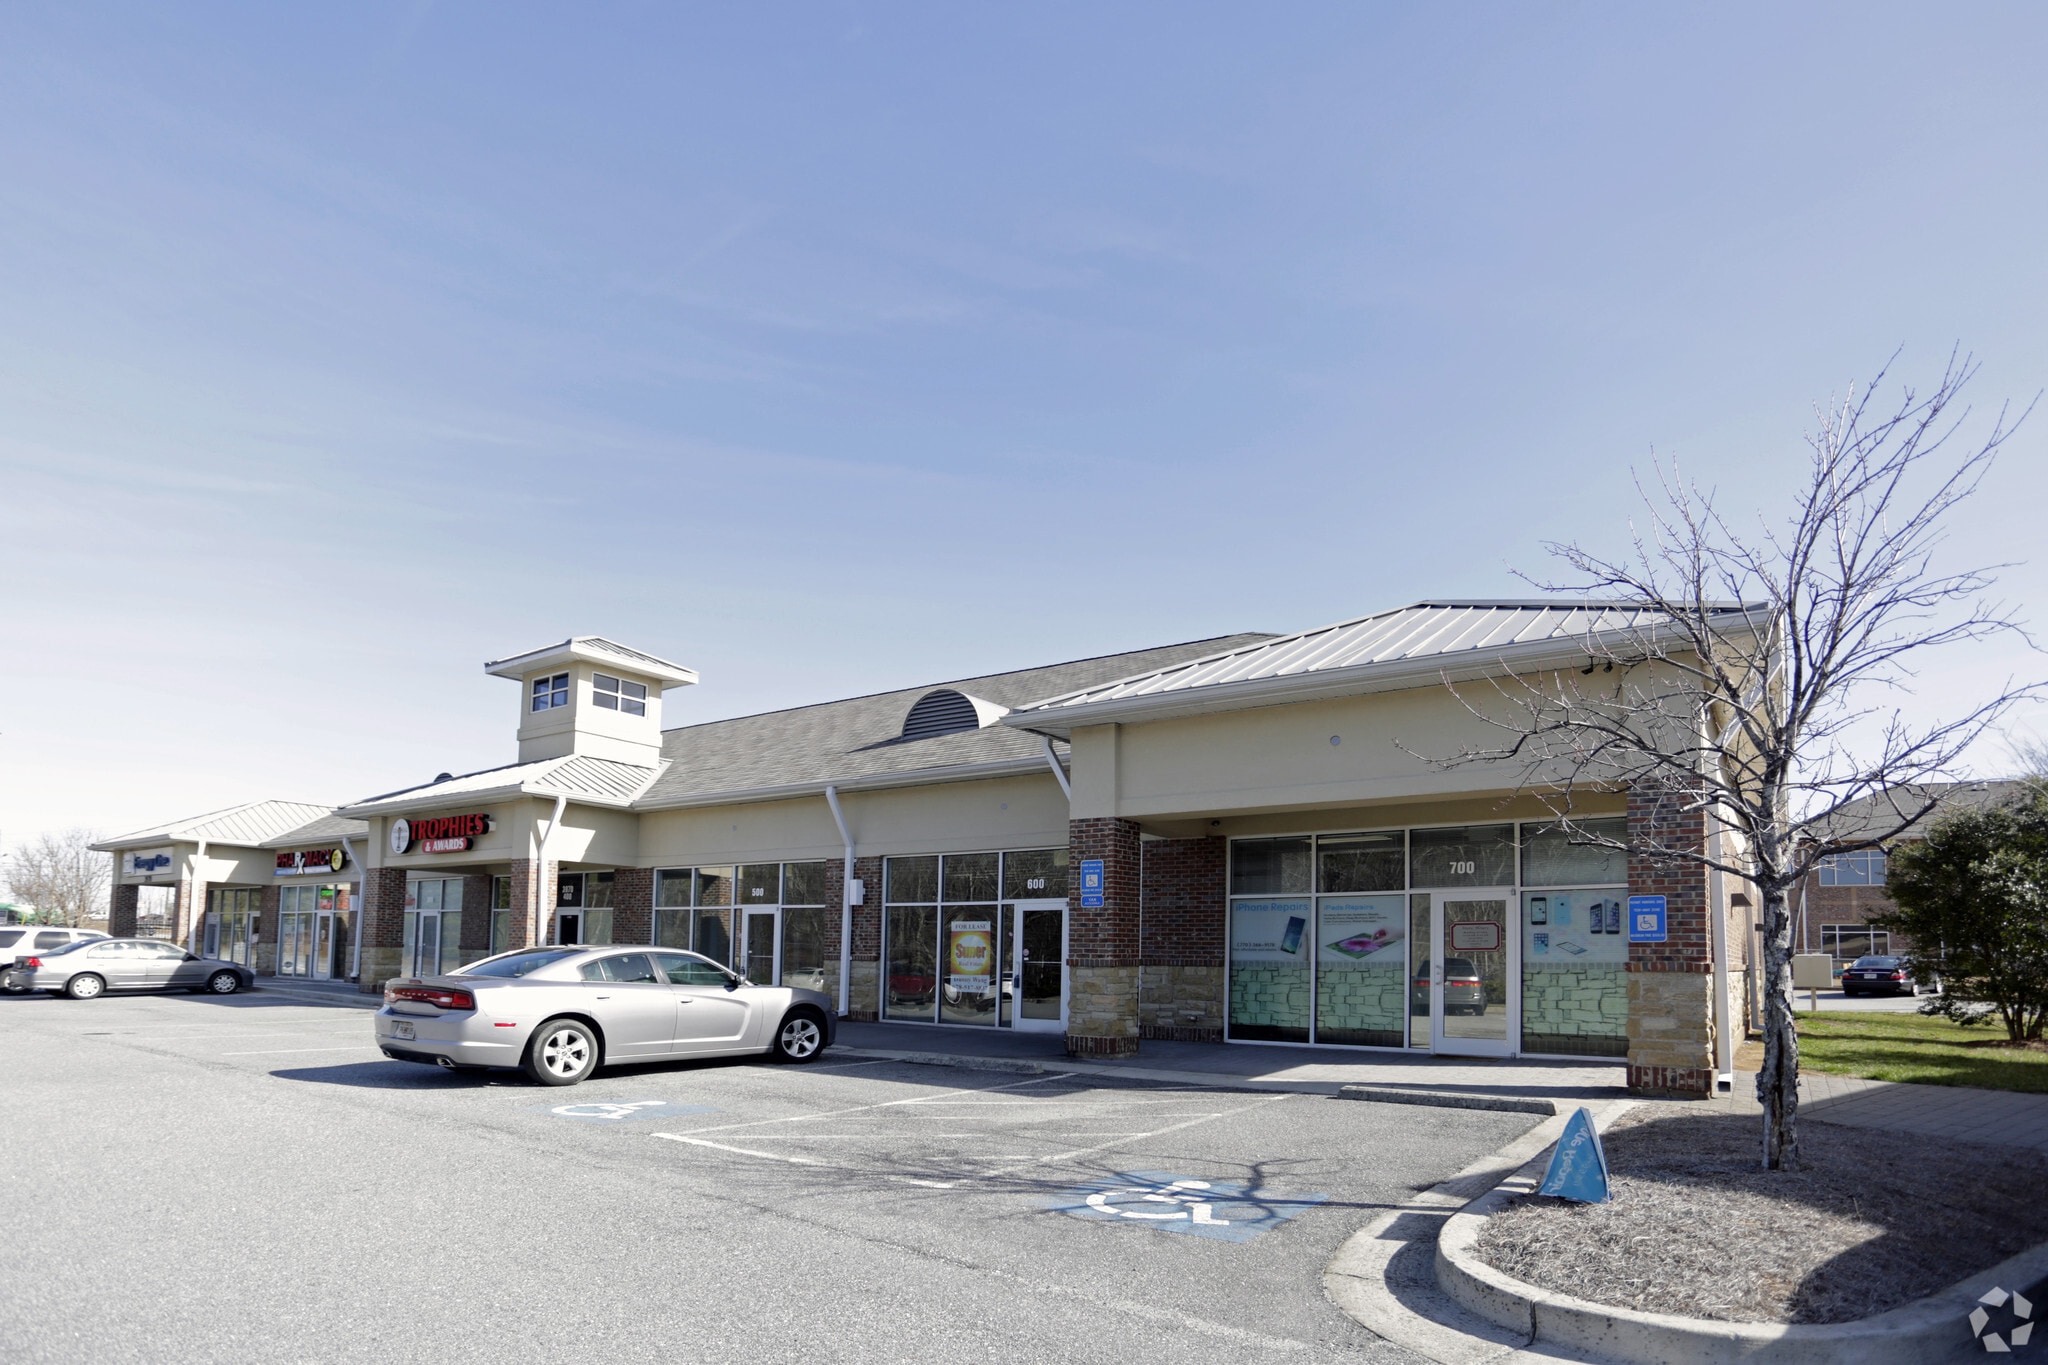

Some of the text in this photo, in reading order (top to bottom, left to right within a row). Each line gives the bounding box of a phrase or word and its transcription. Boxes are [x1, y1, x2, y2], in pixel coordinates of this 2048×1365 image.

[410, 813, 485, 841] TROPHIES
[424, 838, 465, 851] & AWARDS
[1449, 861, 1475, 874] 700
[1027, 878, 1045, 889] 600
[752, 887, 764, 897] 500
[1235, 902, 1309, 912] iPhone Repairs
